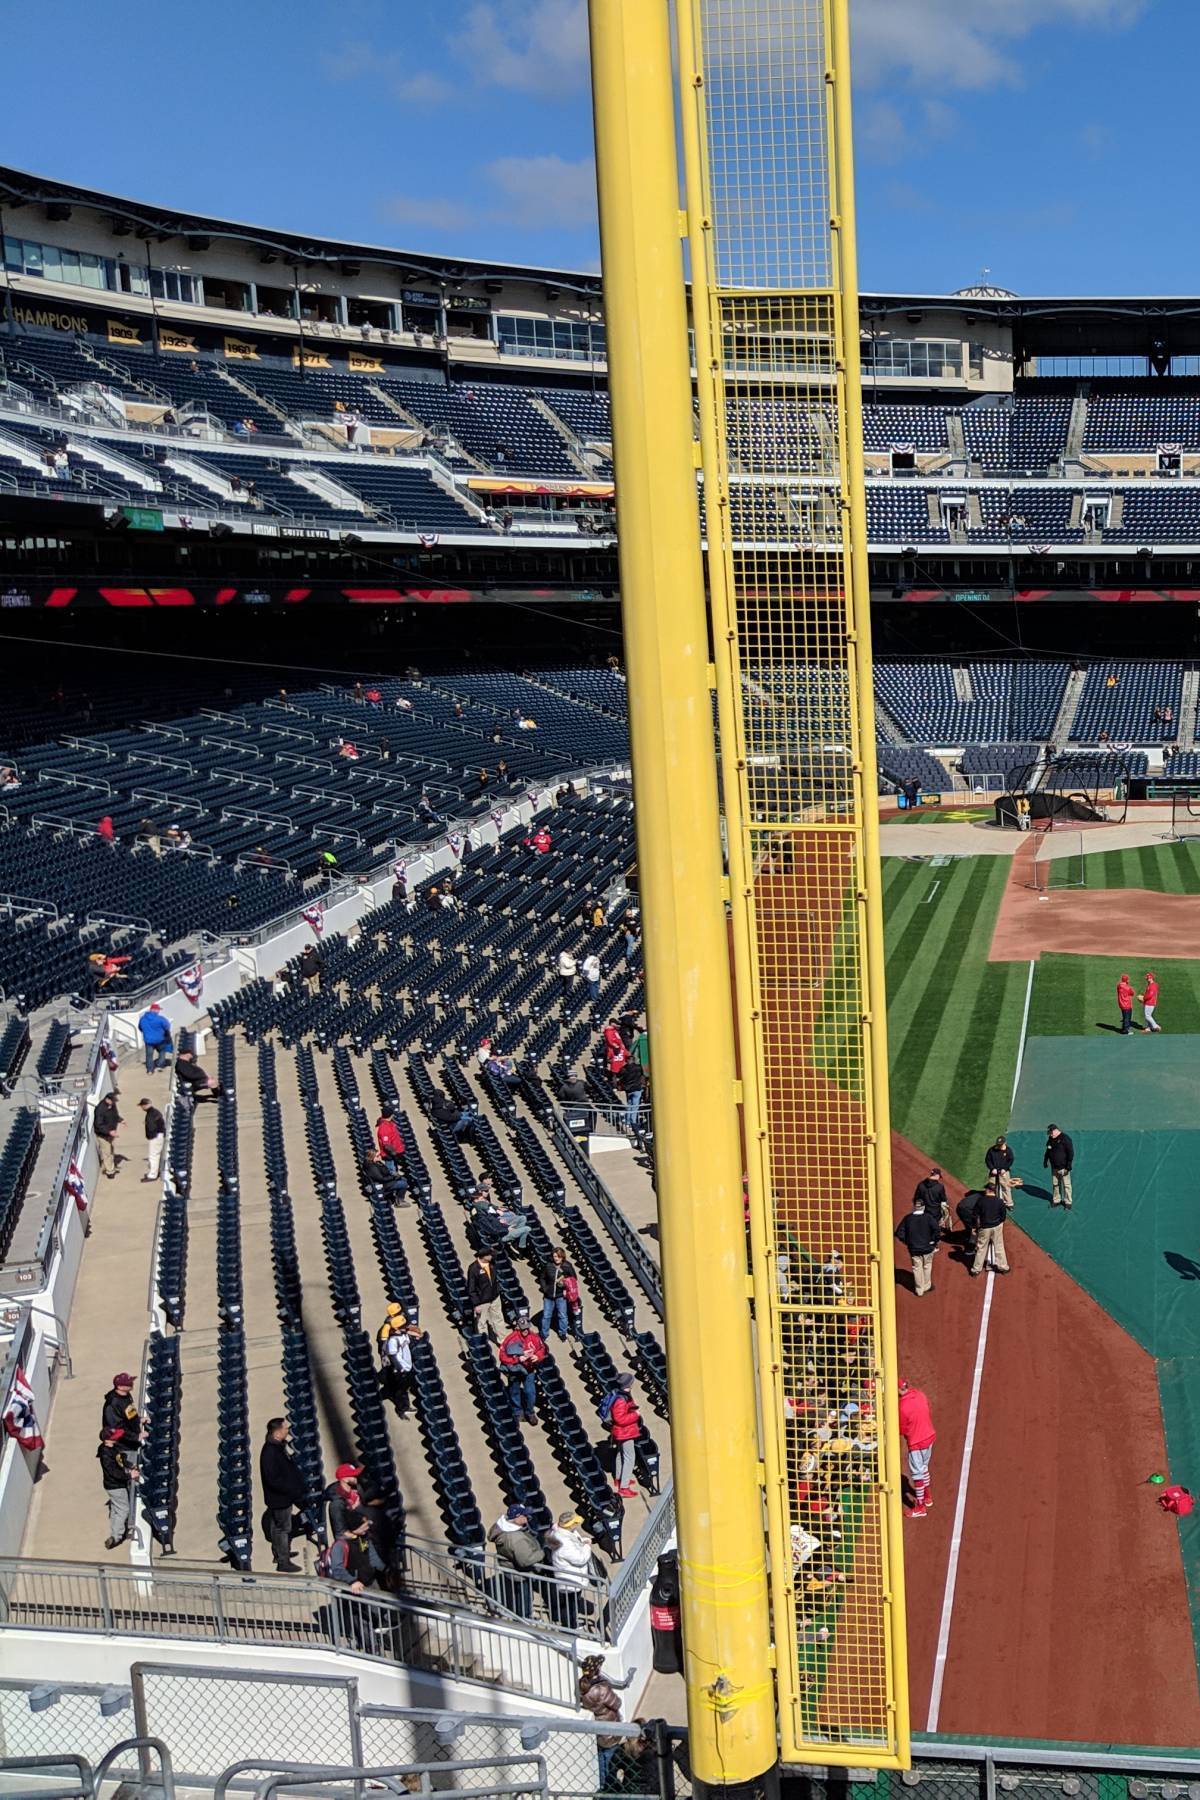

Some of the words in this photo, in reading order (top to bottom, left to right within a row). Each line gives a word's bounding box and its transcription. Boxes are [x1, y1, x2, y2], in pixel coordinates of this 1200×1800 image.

[3, 306, 88, 333] CHAMPIONS
[110, 326, 134, 339] 1909
[162, 335, 188, 348] 1925
[227, 343, 251, 355] 1960
[350, 357, 376, 369] 1979
[306, 530, 329, 539] LEVEL
